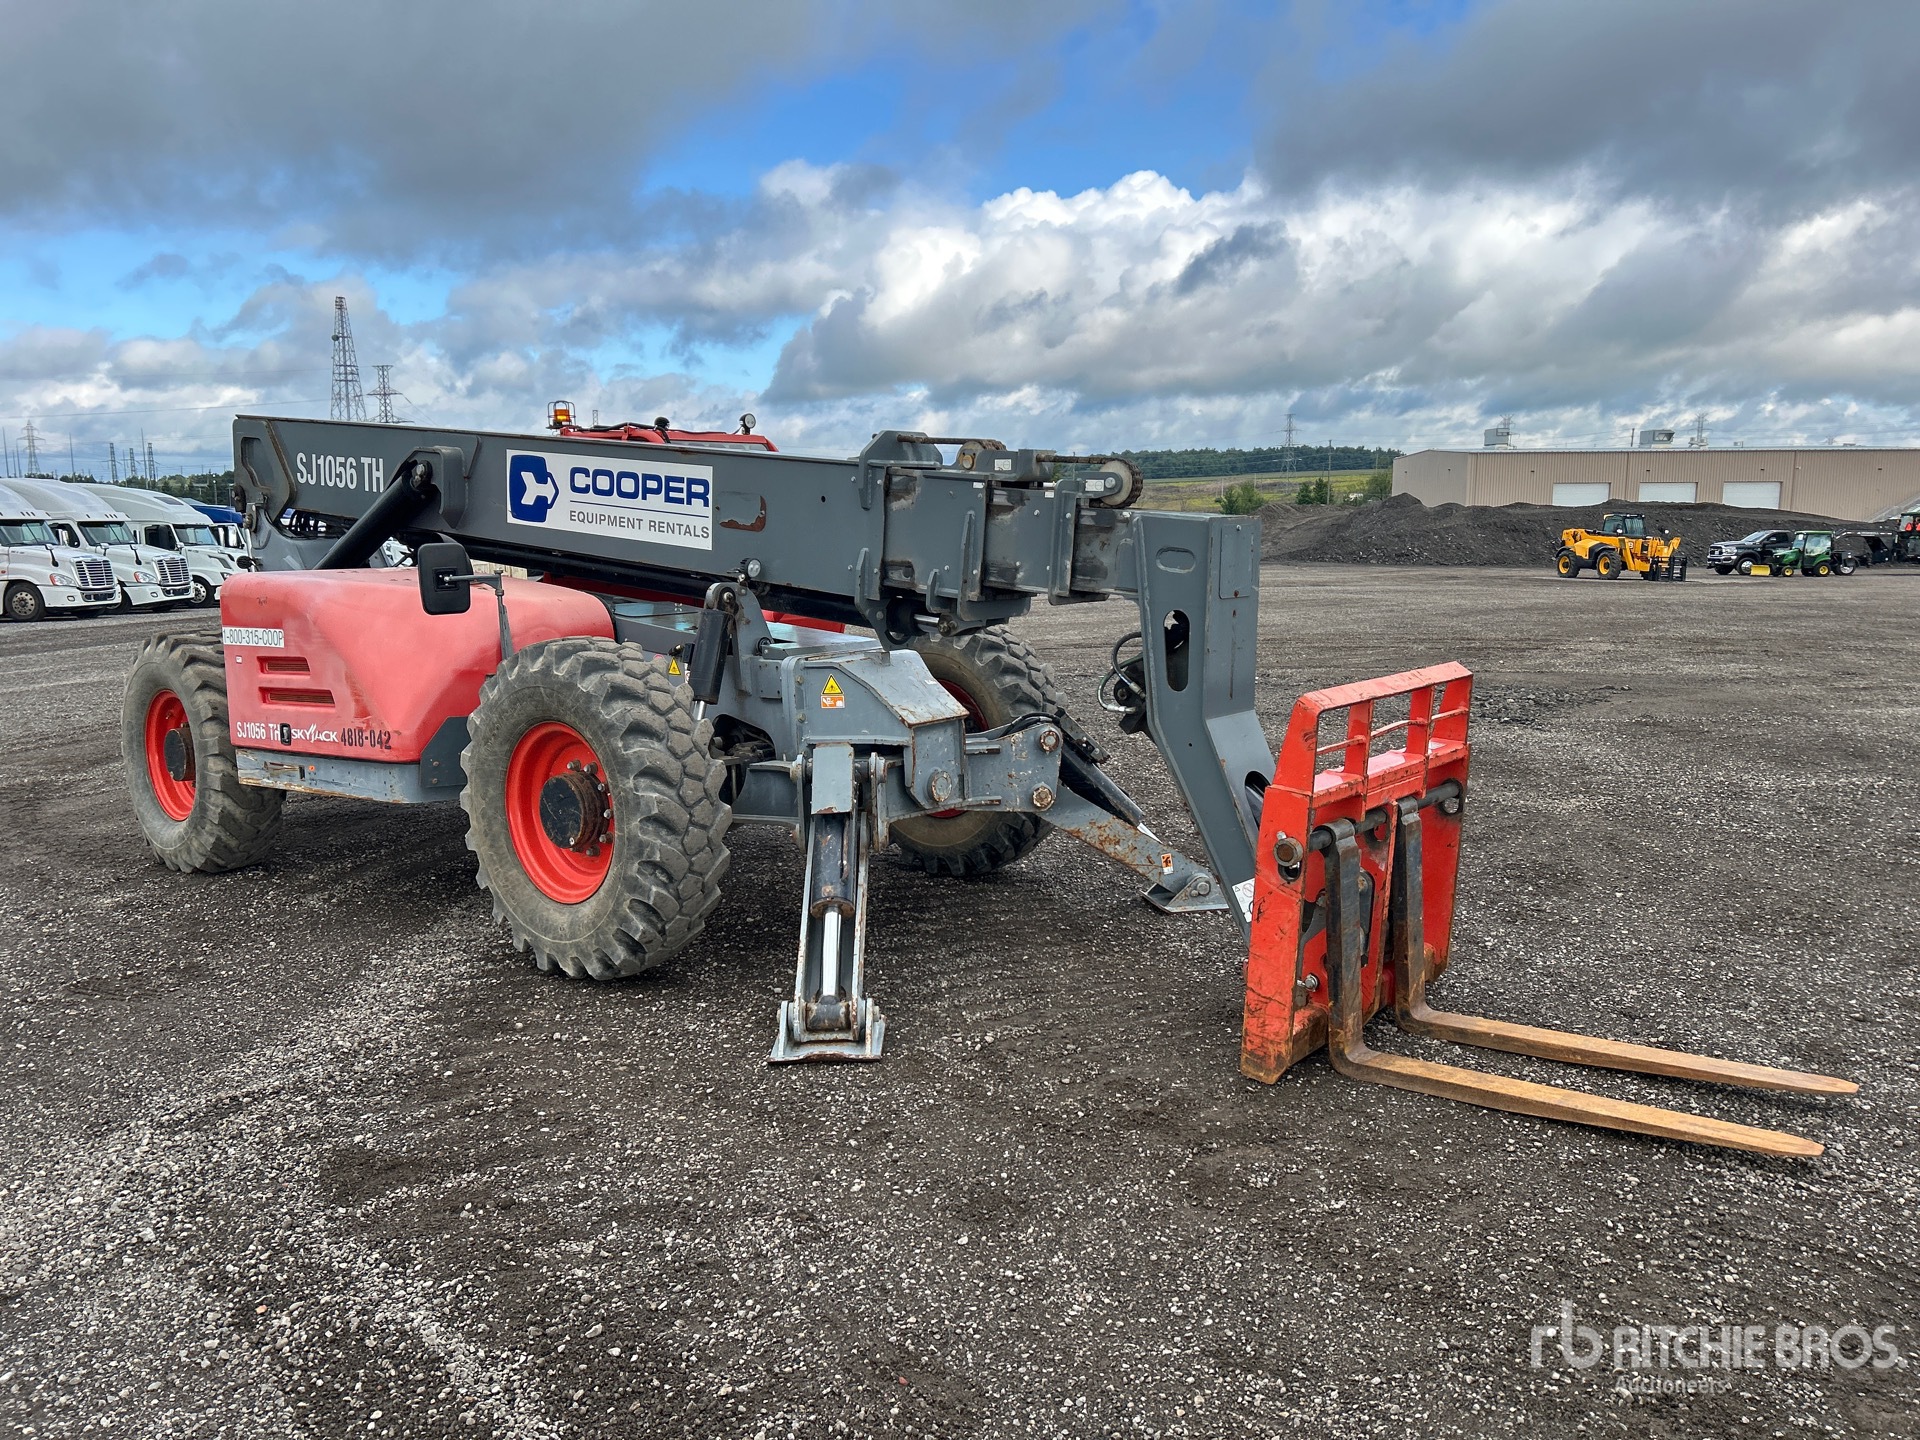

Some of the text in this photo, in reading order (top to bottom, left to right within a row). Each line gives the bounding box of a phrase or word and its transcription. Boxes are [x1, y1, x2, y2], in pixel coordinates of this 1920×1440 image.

[296, 451, 384, 493] SJ1056 TH
[569, 466, 710, 508] COOPER
[569, 510, 710, 539] EQUIPMENT RENTALS
[222, 628, 283, 647] 1-800-315-COOP
[236, 721, 267, 739] SJ1056
[291, 723, 339, 743] SKYJACK
[340, 727, 392, 750] 4818-042
